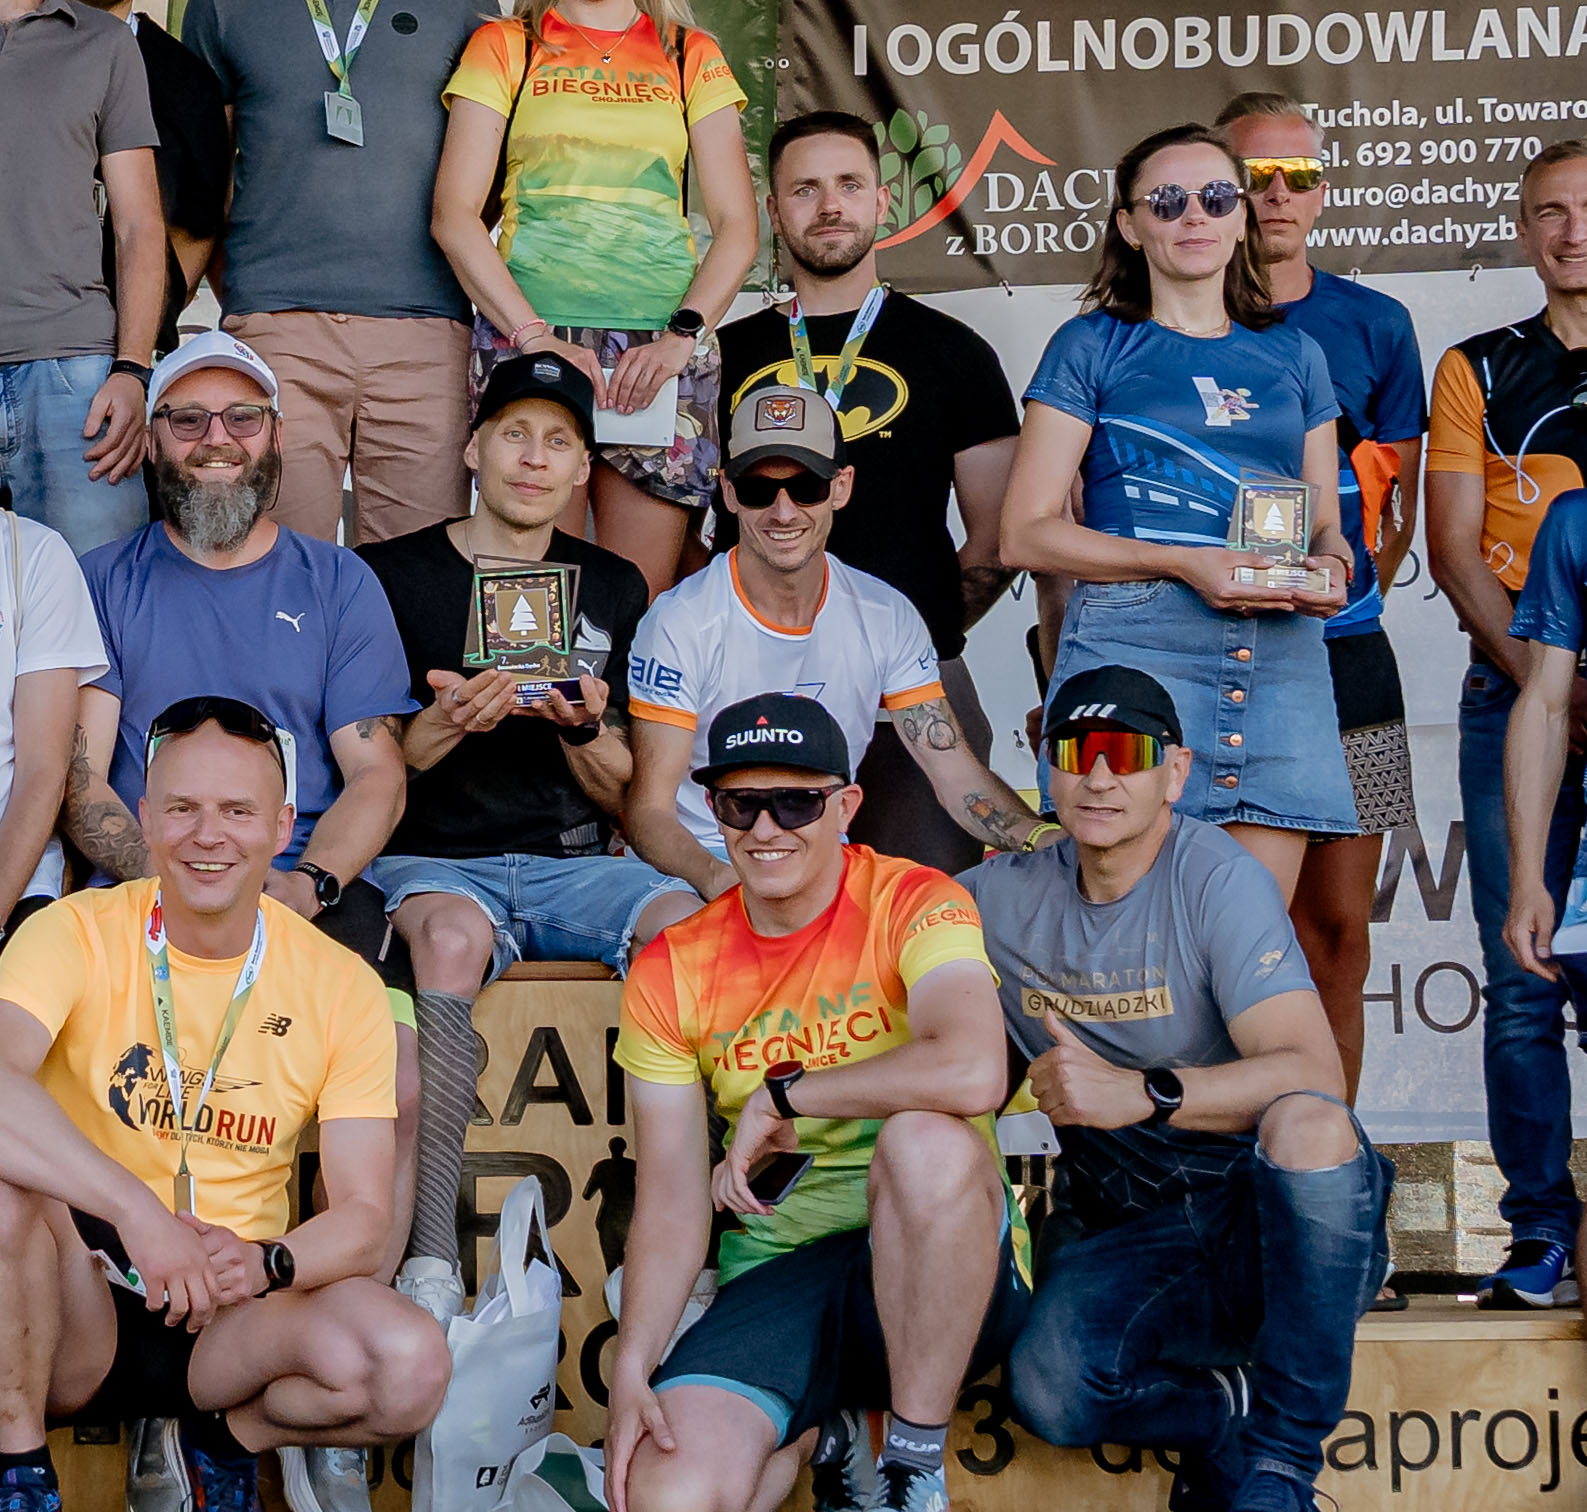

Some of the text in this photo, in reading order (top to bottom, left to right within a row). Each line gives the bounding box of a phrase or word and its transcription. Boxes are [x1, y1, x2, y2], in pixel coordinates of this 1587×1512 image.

[852, 23, 867, 76] I
[1303, 100, 1427, 129] Tuchola,
[1435, 98, 1473, 126] ul.
[1320, 136, 1543, 168] el. 692 900 770
[983, 169, 1116, 212] DAC
[945, 212, 1110, 256] z BORÓ
[725, 728, 803, 749] SUUNTO
[216, 1109, 276, 1146] RUN
[956, 1382, 1016, 1476] 3
